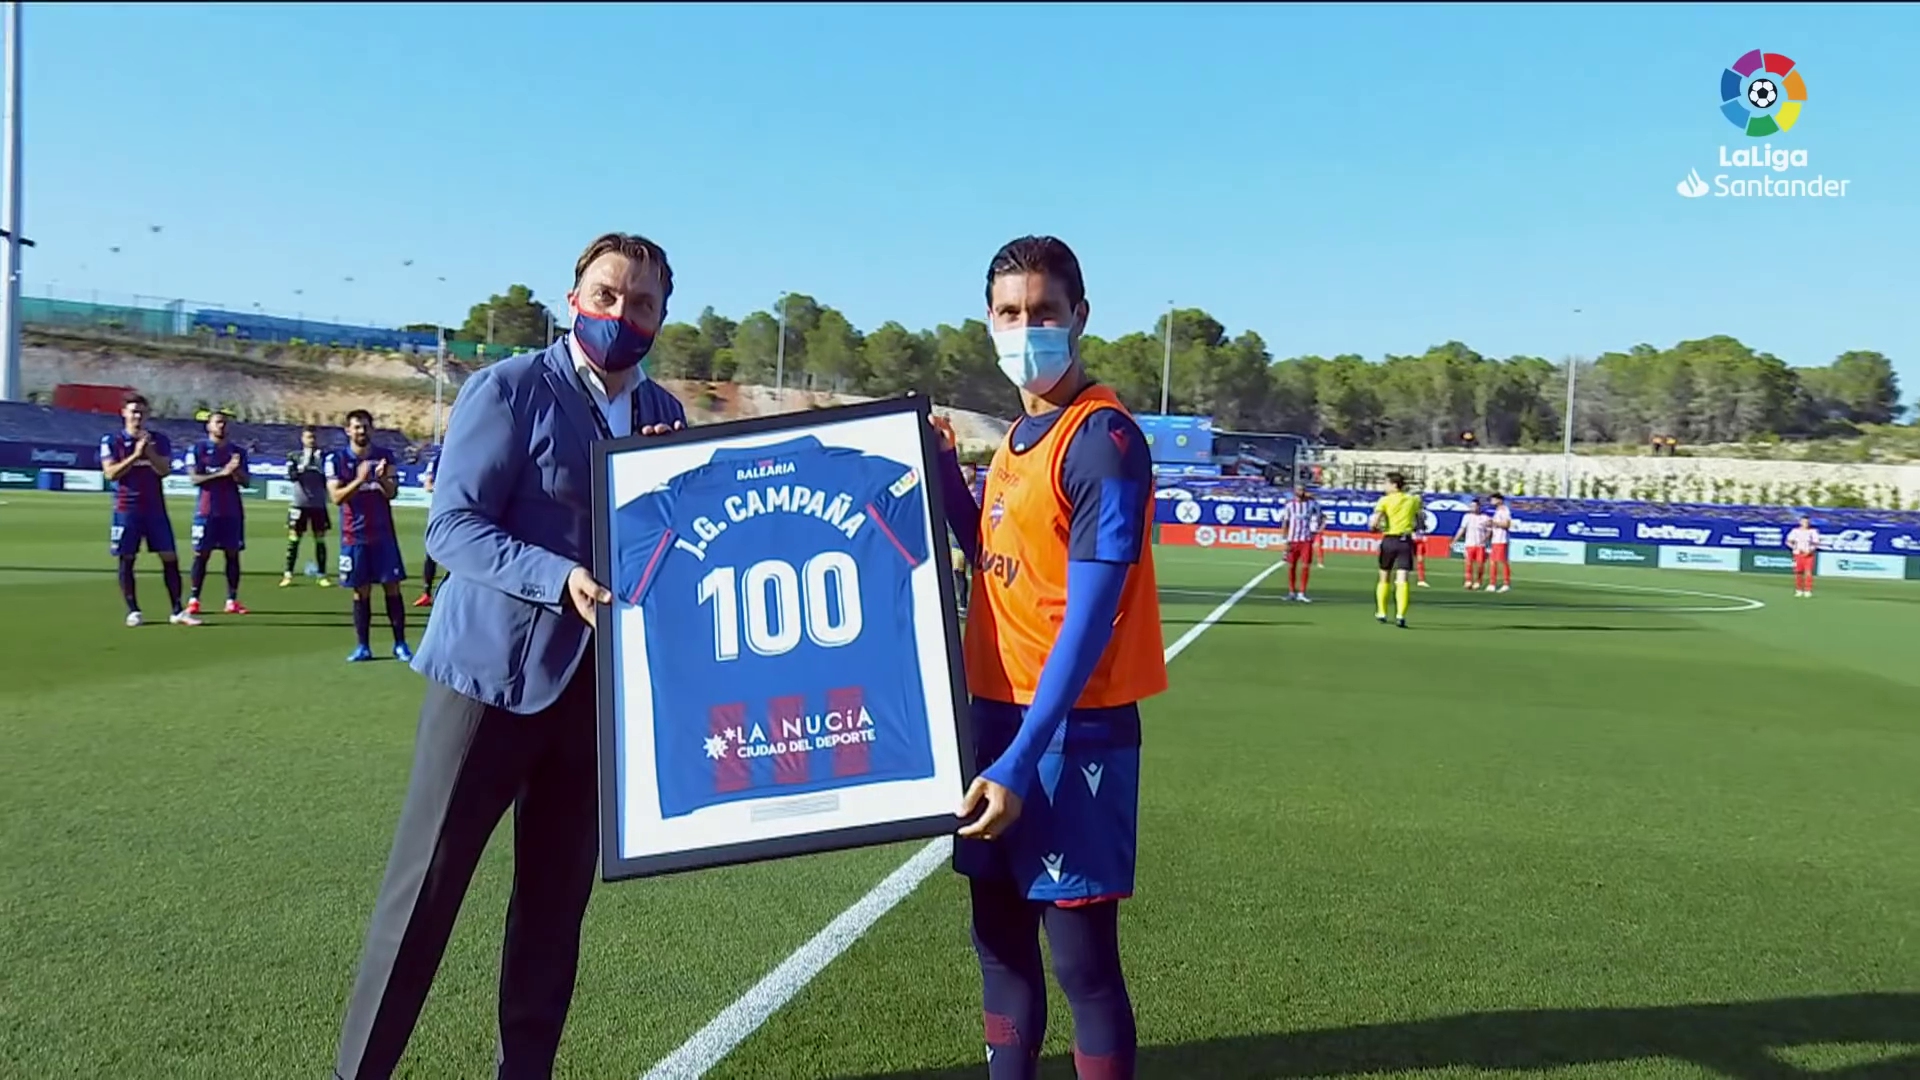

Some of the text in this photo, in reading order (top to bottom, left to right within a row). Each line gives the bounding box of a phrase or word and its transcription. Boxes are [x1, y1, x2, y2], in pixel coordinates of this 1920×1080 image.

[674, 485, 866, 562] J.G. CAMPAÑA
[1339, 510, 1368, 526] UD
[1636, 523, 1712, 544] betway
[697, 551, 863, 662] 100
[736, 728, 876, 758] CIUDAD DEL DEPORTE
[737, 721, 767, 744] LA
